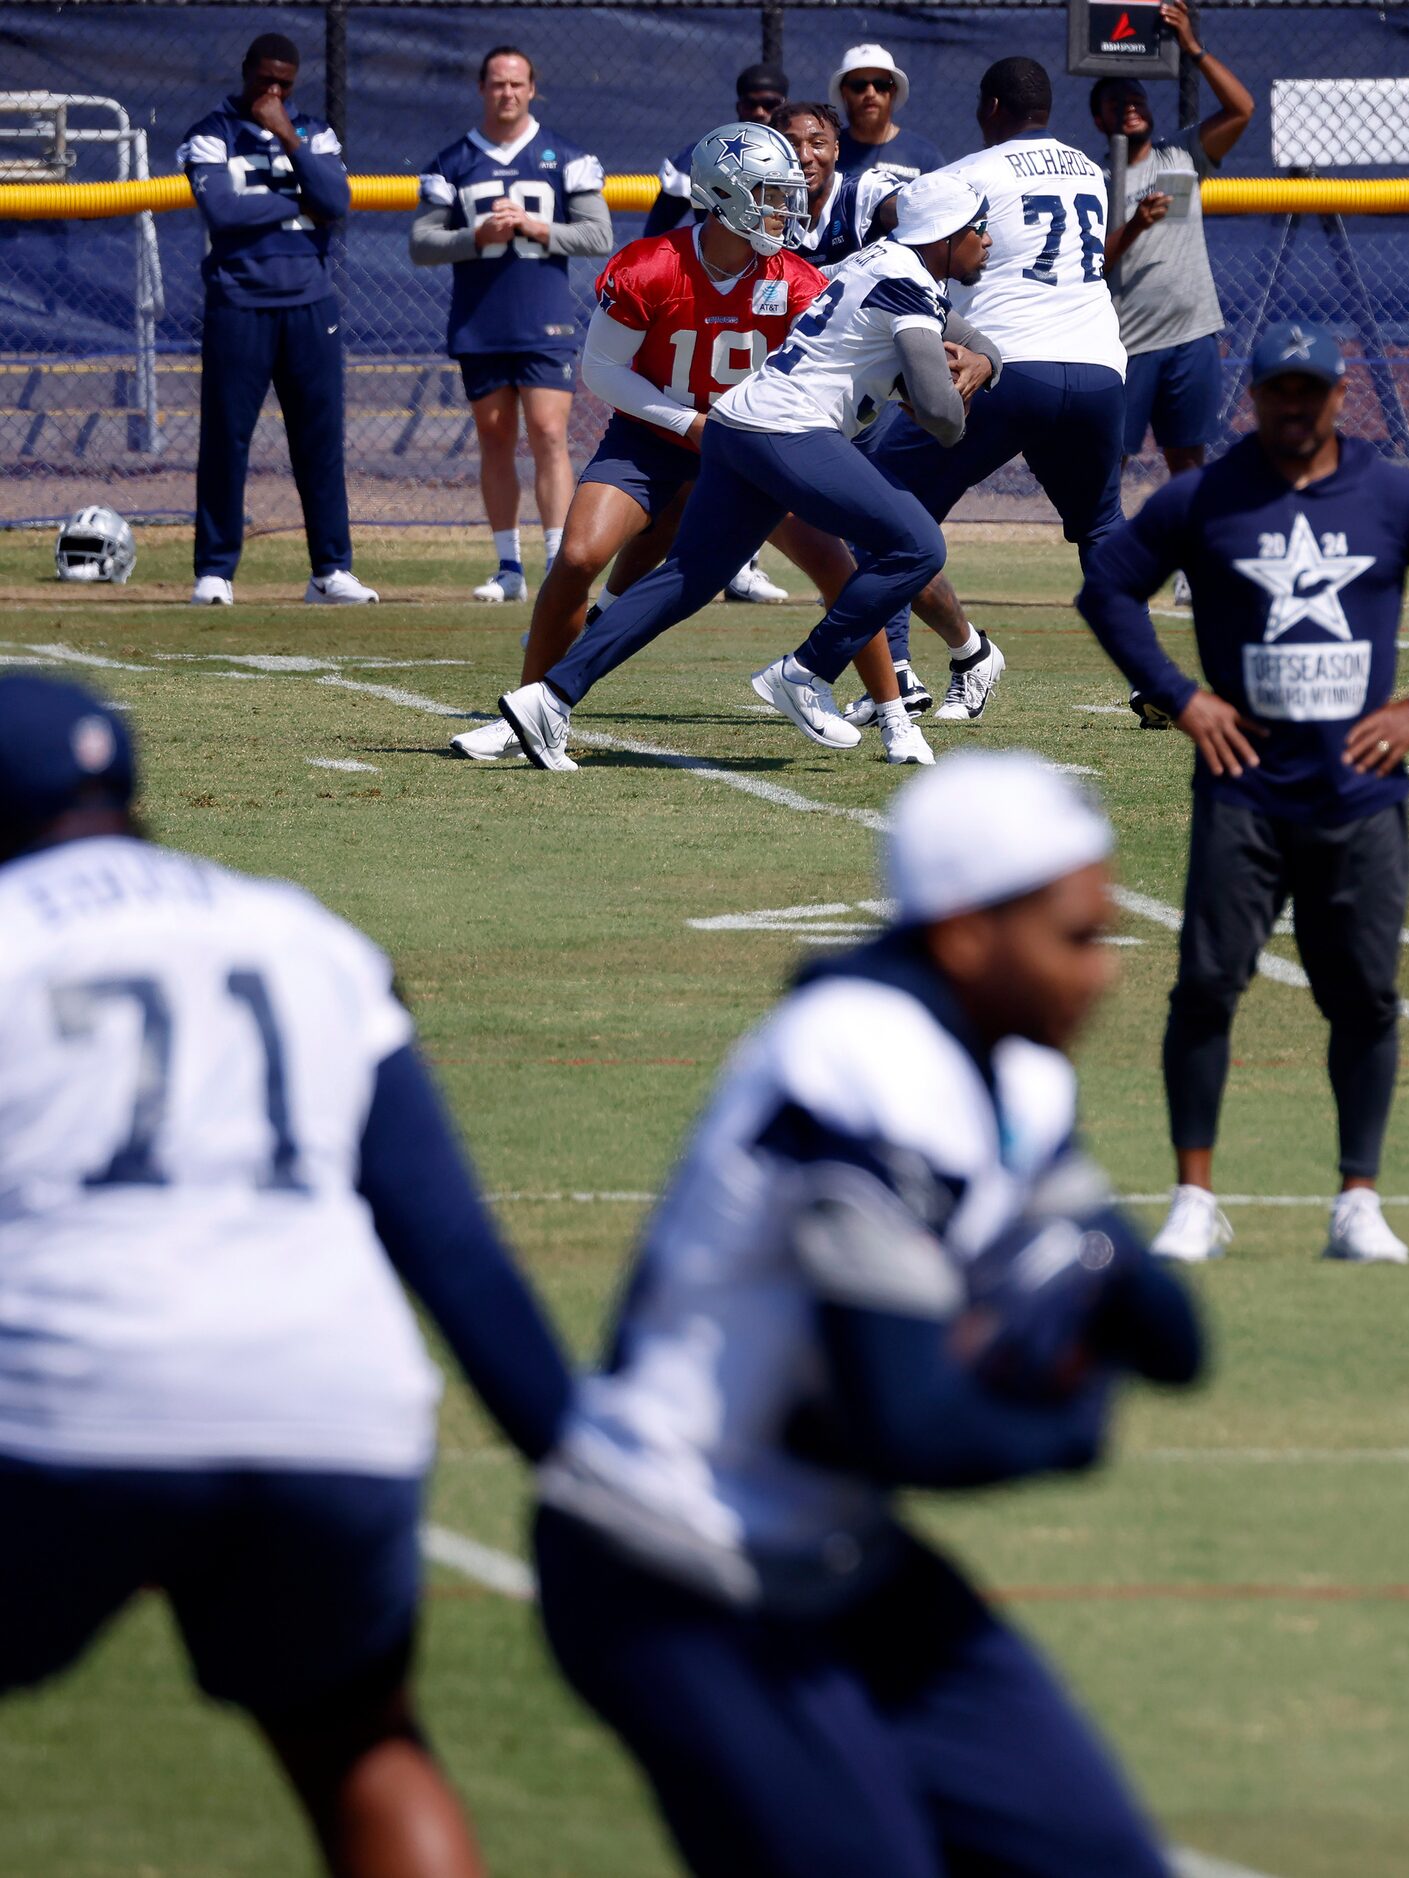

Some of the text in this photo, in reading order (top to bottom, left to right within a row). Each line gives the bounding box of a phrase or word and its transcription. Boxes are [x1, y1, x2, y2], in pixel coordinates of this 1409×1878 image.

[1005, 148, 1096, 177] RICHARDS
[1021, 193, 1106, 286] 76
[759, 303, 780, 312] AT&T
[663, 329, 768, 407] 19
[1258, 532, 1349, 558] 20 24
[52, 970, 312, 1190] 71
